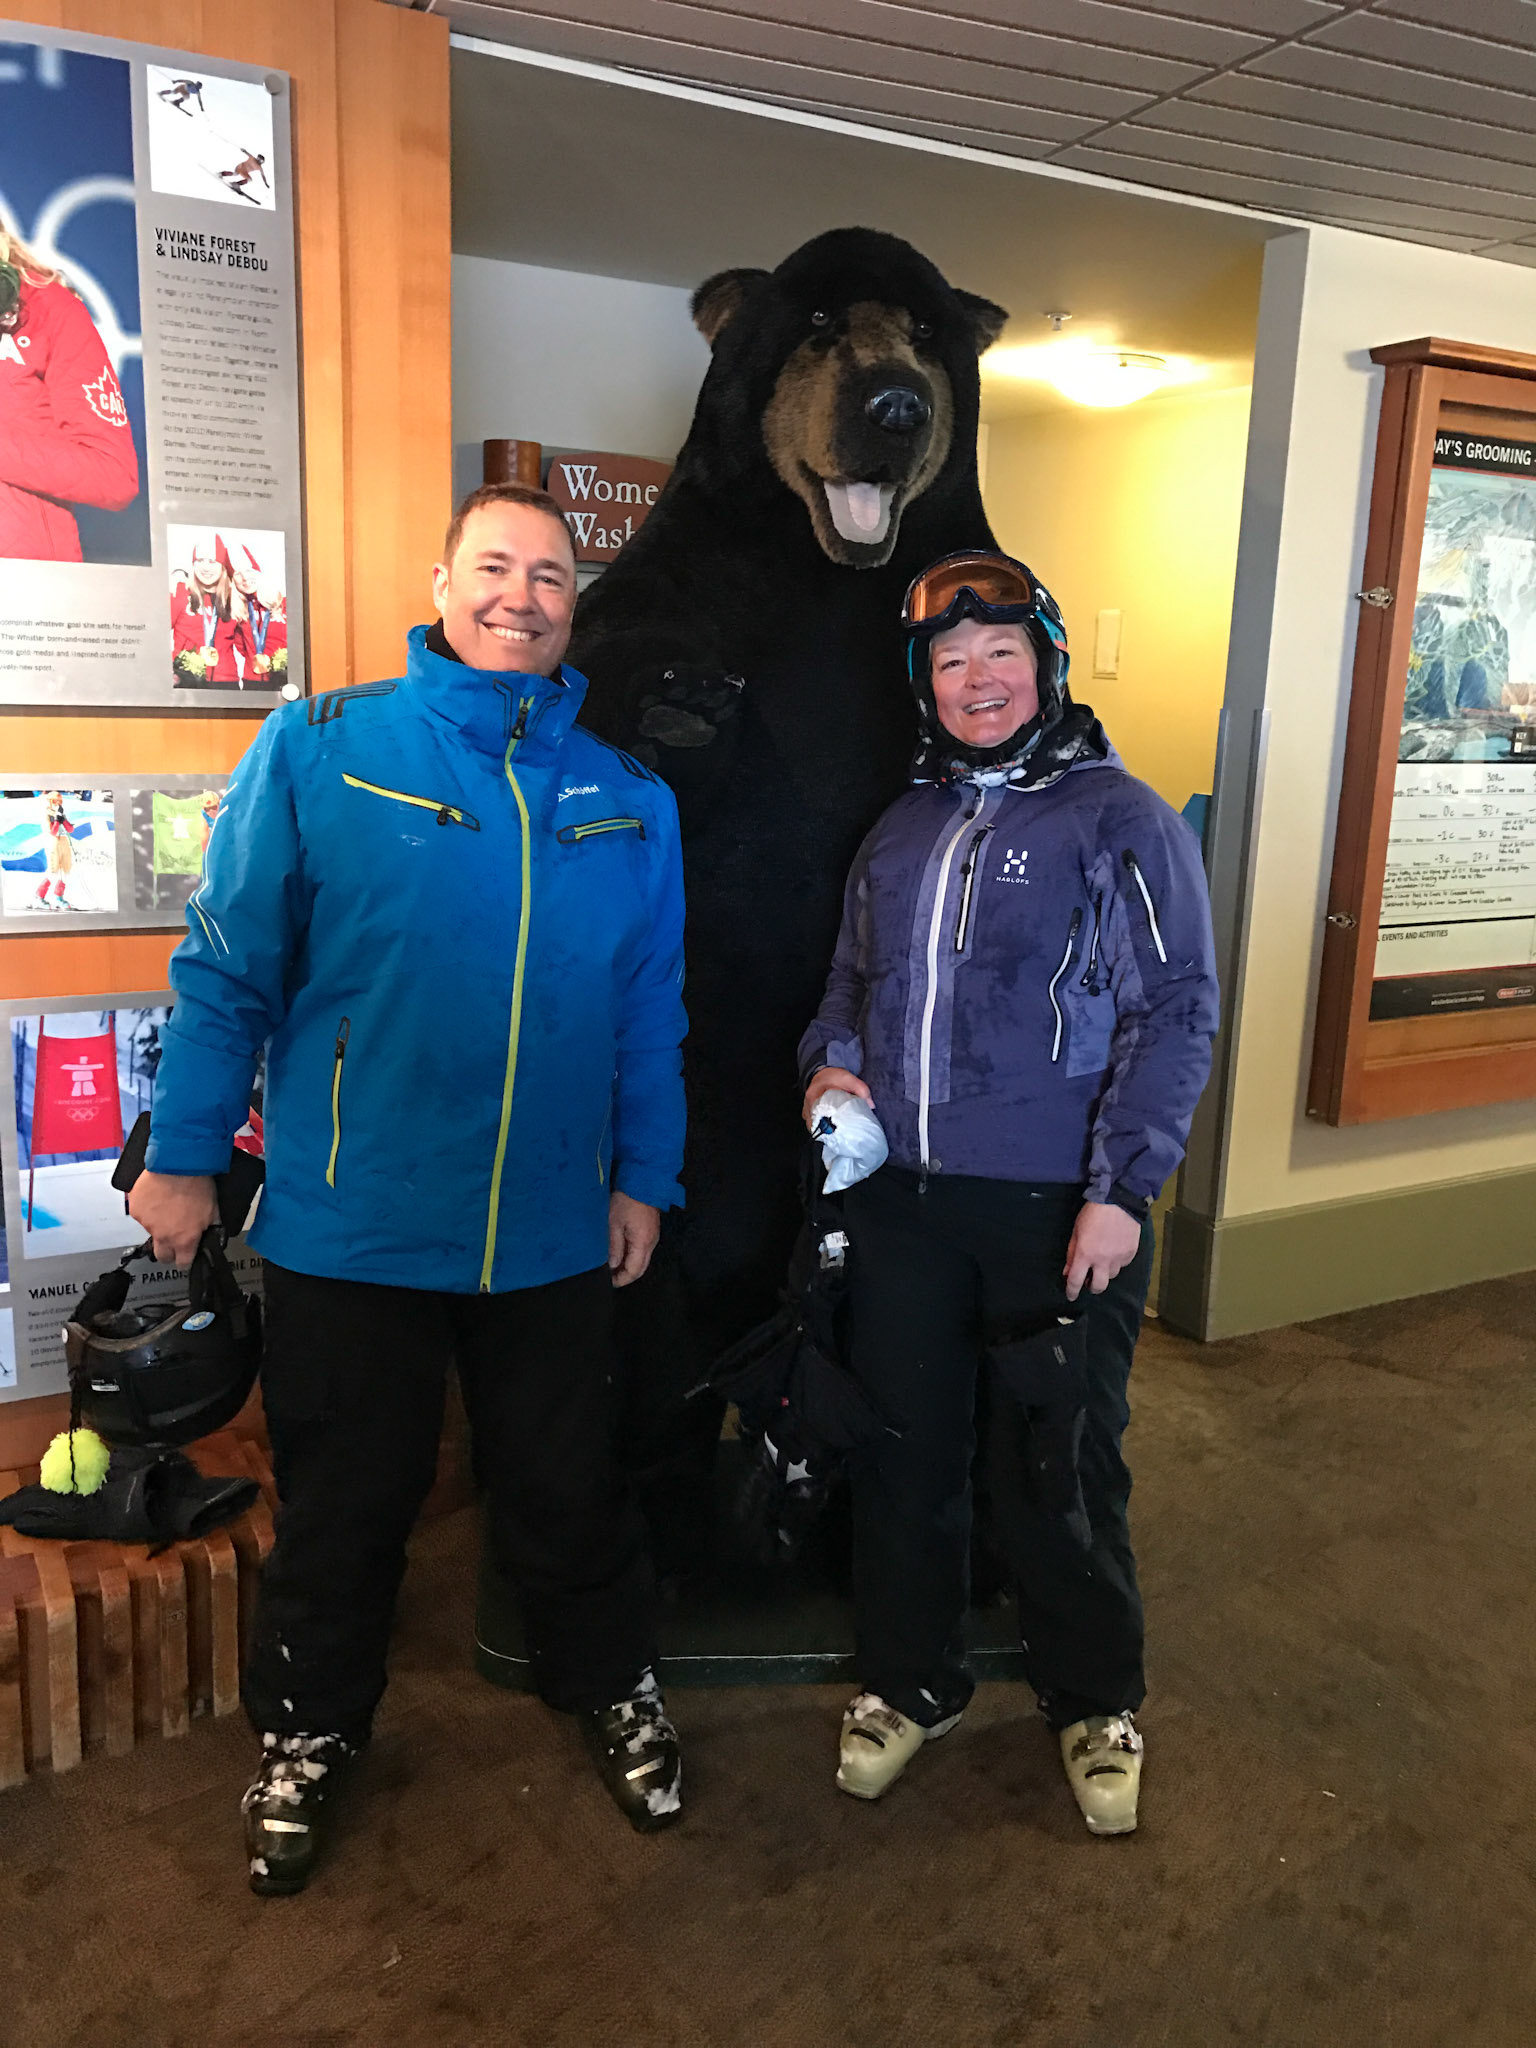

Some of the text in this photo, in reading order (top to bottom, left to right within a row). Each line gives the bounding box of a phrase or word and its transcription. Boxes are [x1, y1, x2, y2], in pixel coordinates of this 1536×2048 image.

[155, 227, 256, 254] VIVIANE FOREST
[156, 243, 268, 271] & LINDSAY DEBOU
[1466, 442, 1531, 466] GROOMING
[1381, 931, 1404, 943] EVENTS
[1405, 930, 1418, 941] AND
[1418, 929, 1449, 939] ACTIVITIES
[28, 1283, 79, 1299] MANUEL
